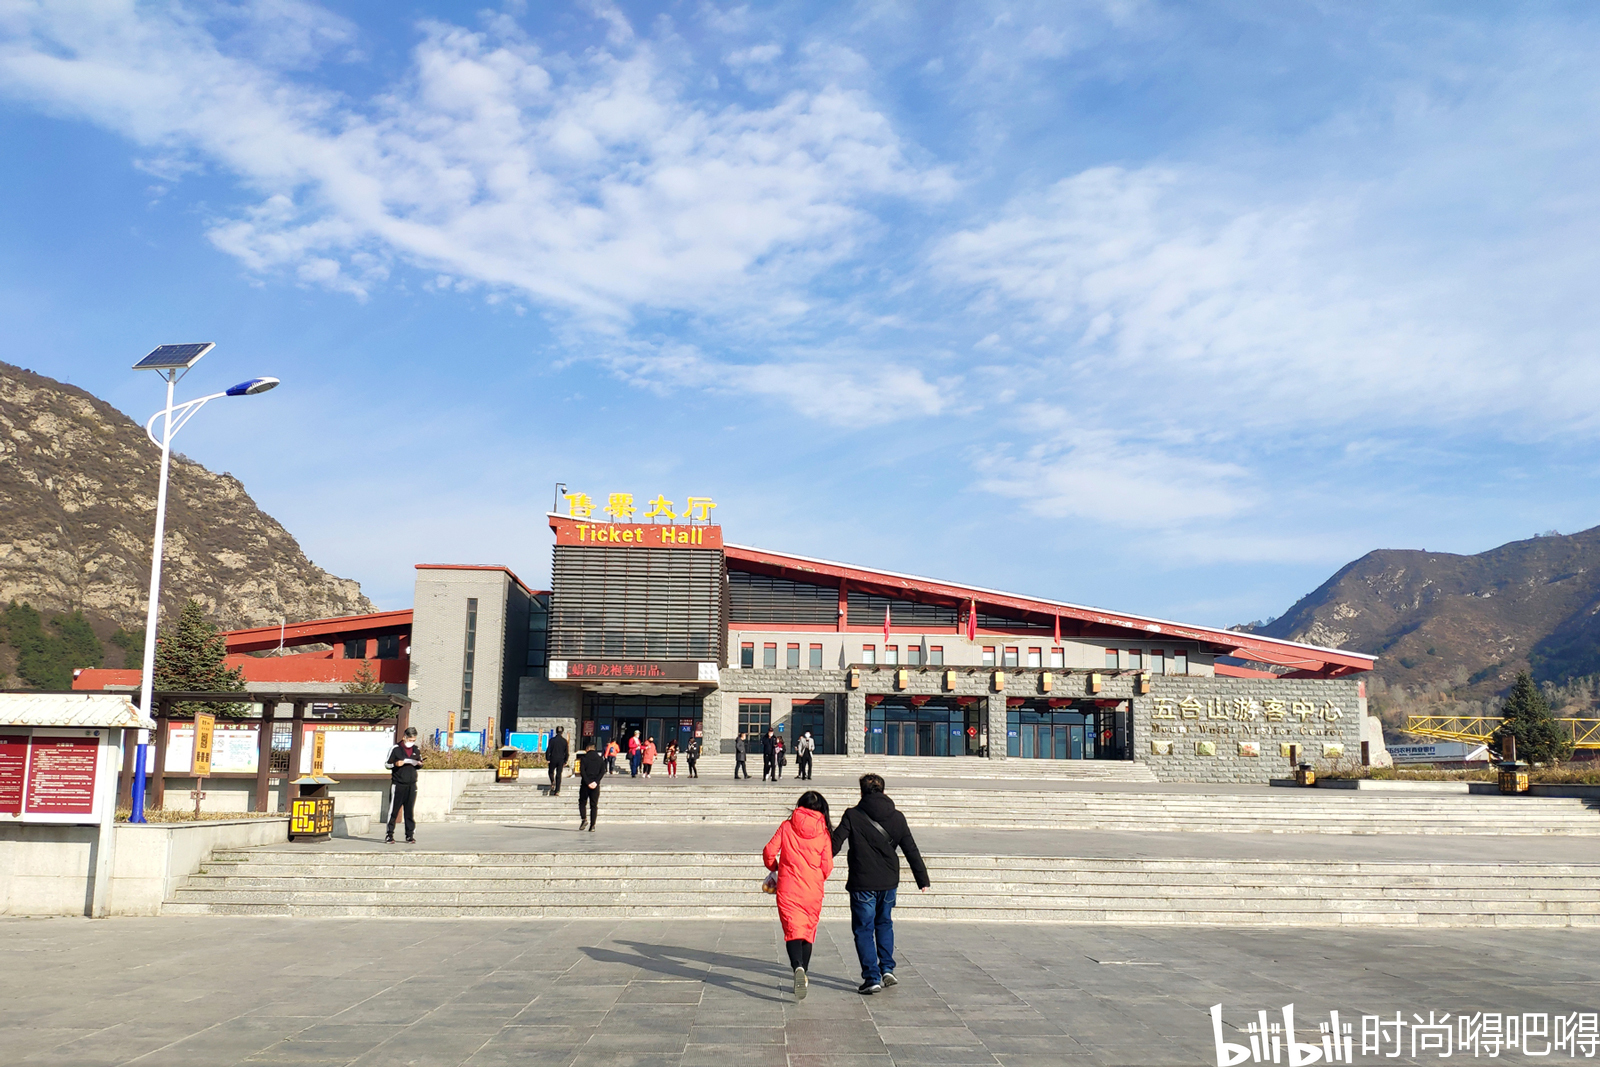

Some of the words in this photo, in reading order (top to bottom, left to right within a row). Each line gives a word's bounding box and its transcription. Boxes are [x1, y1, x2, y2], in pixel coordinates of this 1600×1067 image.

[563, 492, 717, 521] 售票大厅
[576, 524, 643, 543] Ticket
[661, 526, 703, 544] Hall
[1152, 695, 1343, 722] 五台山游客中心
